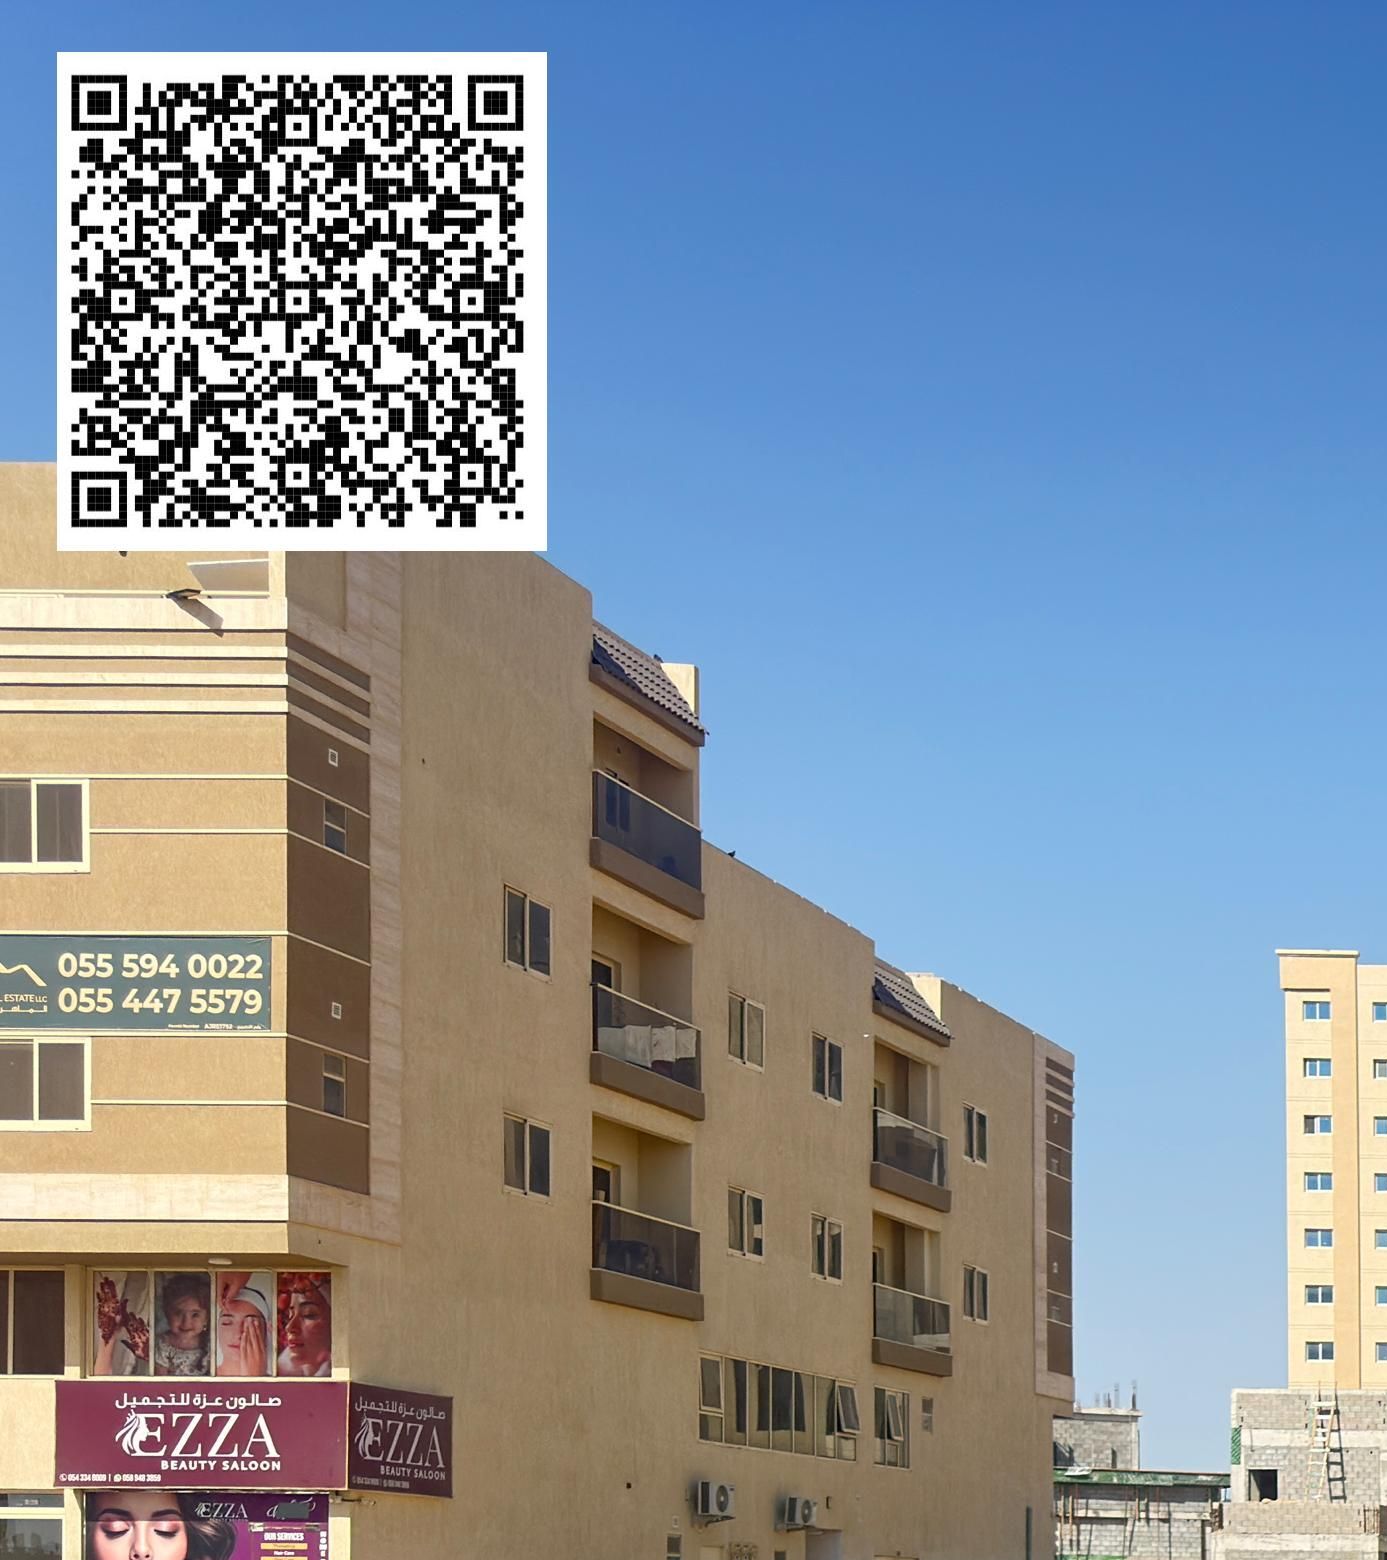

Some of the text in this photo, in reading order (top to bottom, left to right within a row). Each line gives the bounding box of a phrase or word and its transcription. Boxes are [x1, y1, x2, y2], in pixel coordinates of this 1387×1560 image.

[58, 952, 263, 979] 055 594 0022
[4, 994, 35, 1003] ESTATE
[58, 987, 263, 1015] 055 447 5579
[115, 1393, 281, 1410] صالون عزة للتجميل
[355, 1396, 446, 1421] صالون عزة للتجميل
[130, 1412, 281, 1458] EZZA
[364, 1417, 446, 1469] EZZA
[161, 1460, 281, 1471] BEAUTY SALOON
[380, 1465, 446, 1480] BEAUTY SALOON
[200, 1502, 249, 1519] EZZA
